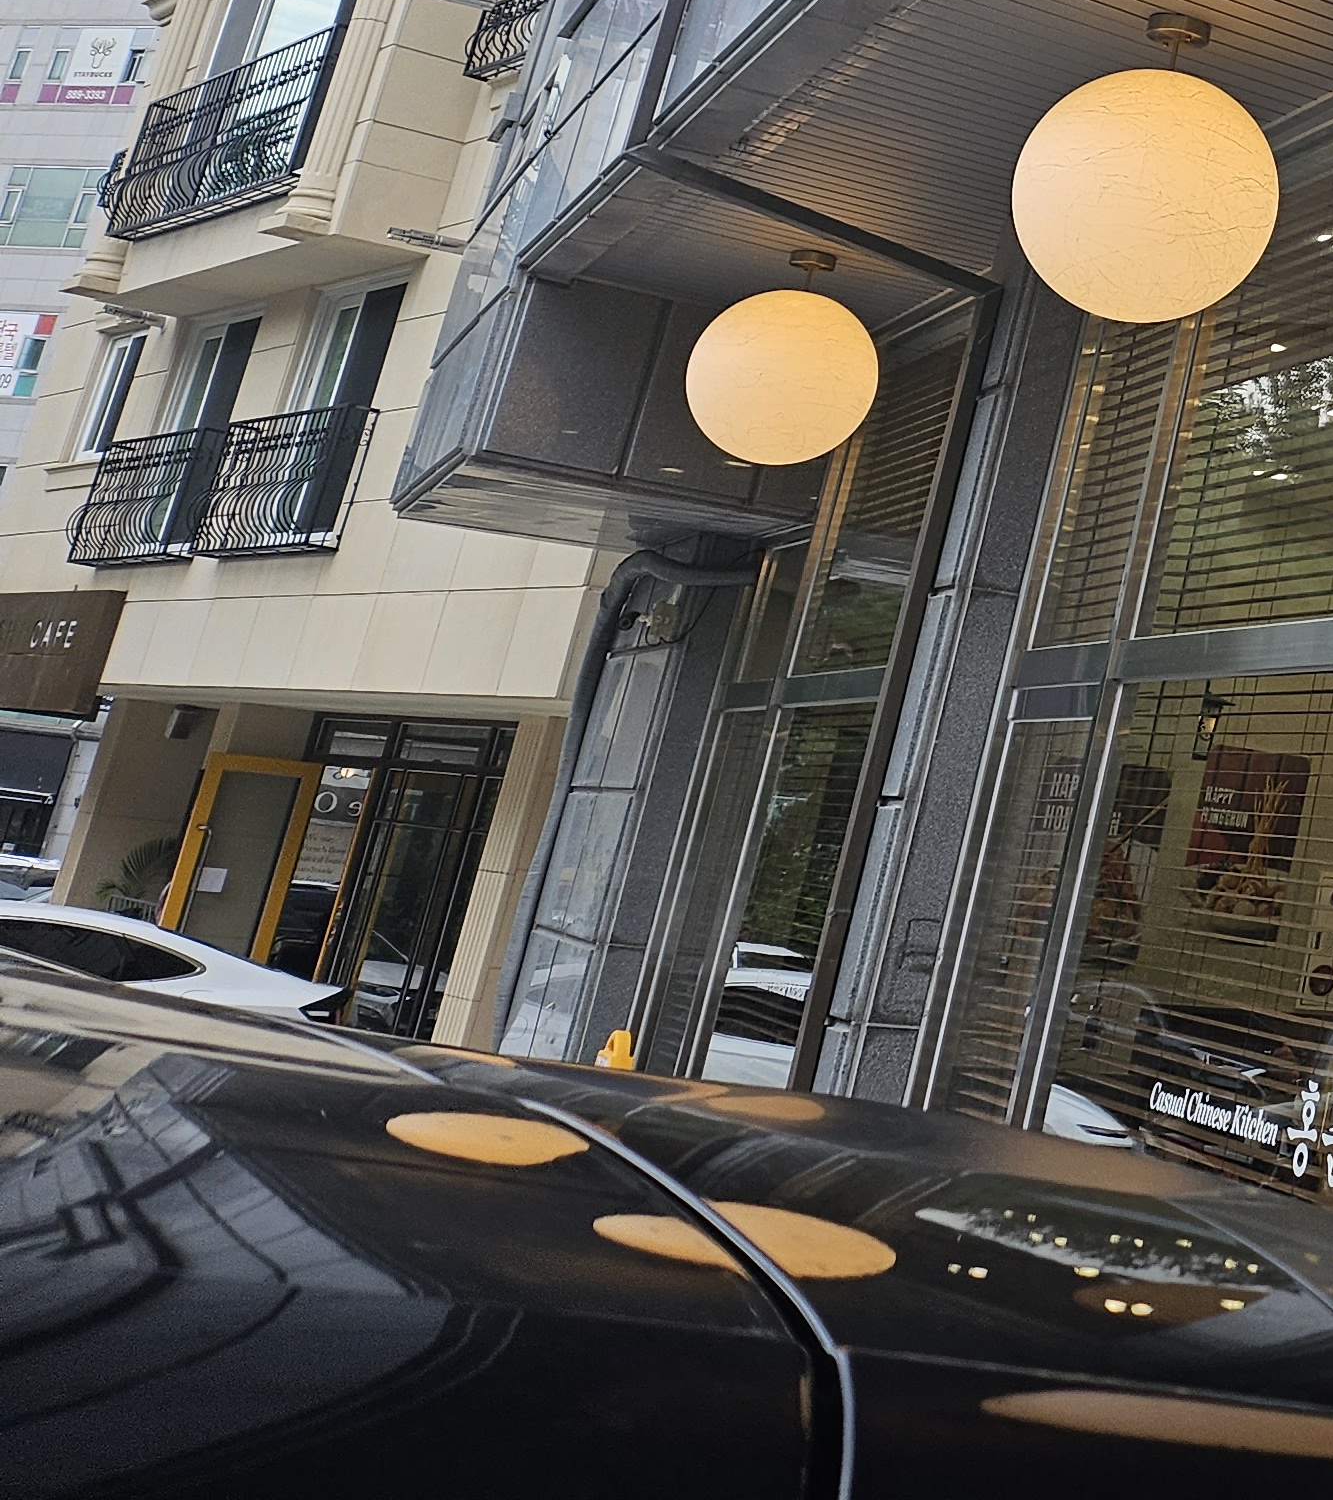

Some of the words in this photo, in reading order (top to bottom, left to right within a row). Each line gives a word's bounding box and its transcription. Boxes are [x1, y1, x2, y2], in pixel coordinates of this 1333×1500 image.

[29, 620, 77, 649] CAFE
[1049, 772, 1080, 799] HAP
[1205, 786, 1235, 805] HAPPY
[1150, 1082, 1190, 1119] Casual
[1187, 1091, 1233, 1132] Chinese
[1231, 1104, 1279, 1146] Kitchen
